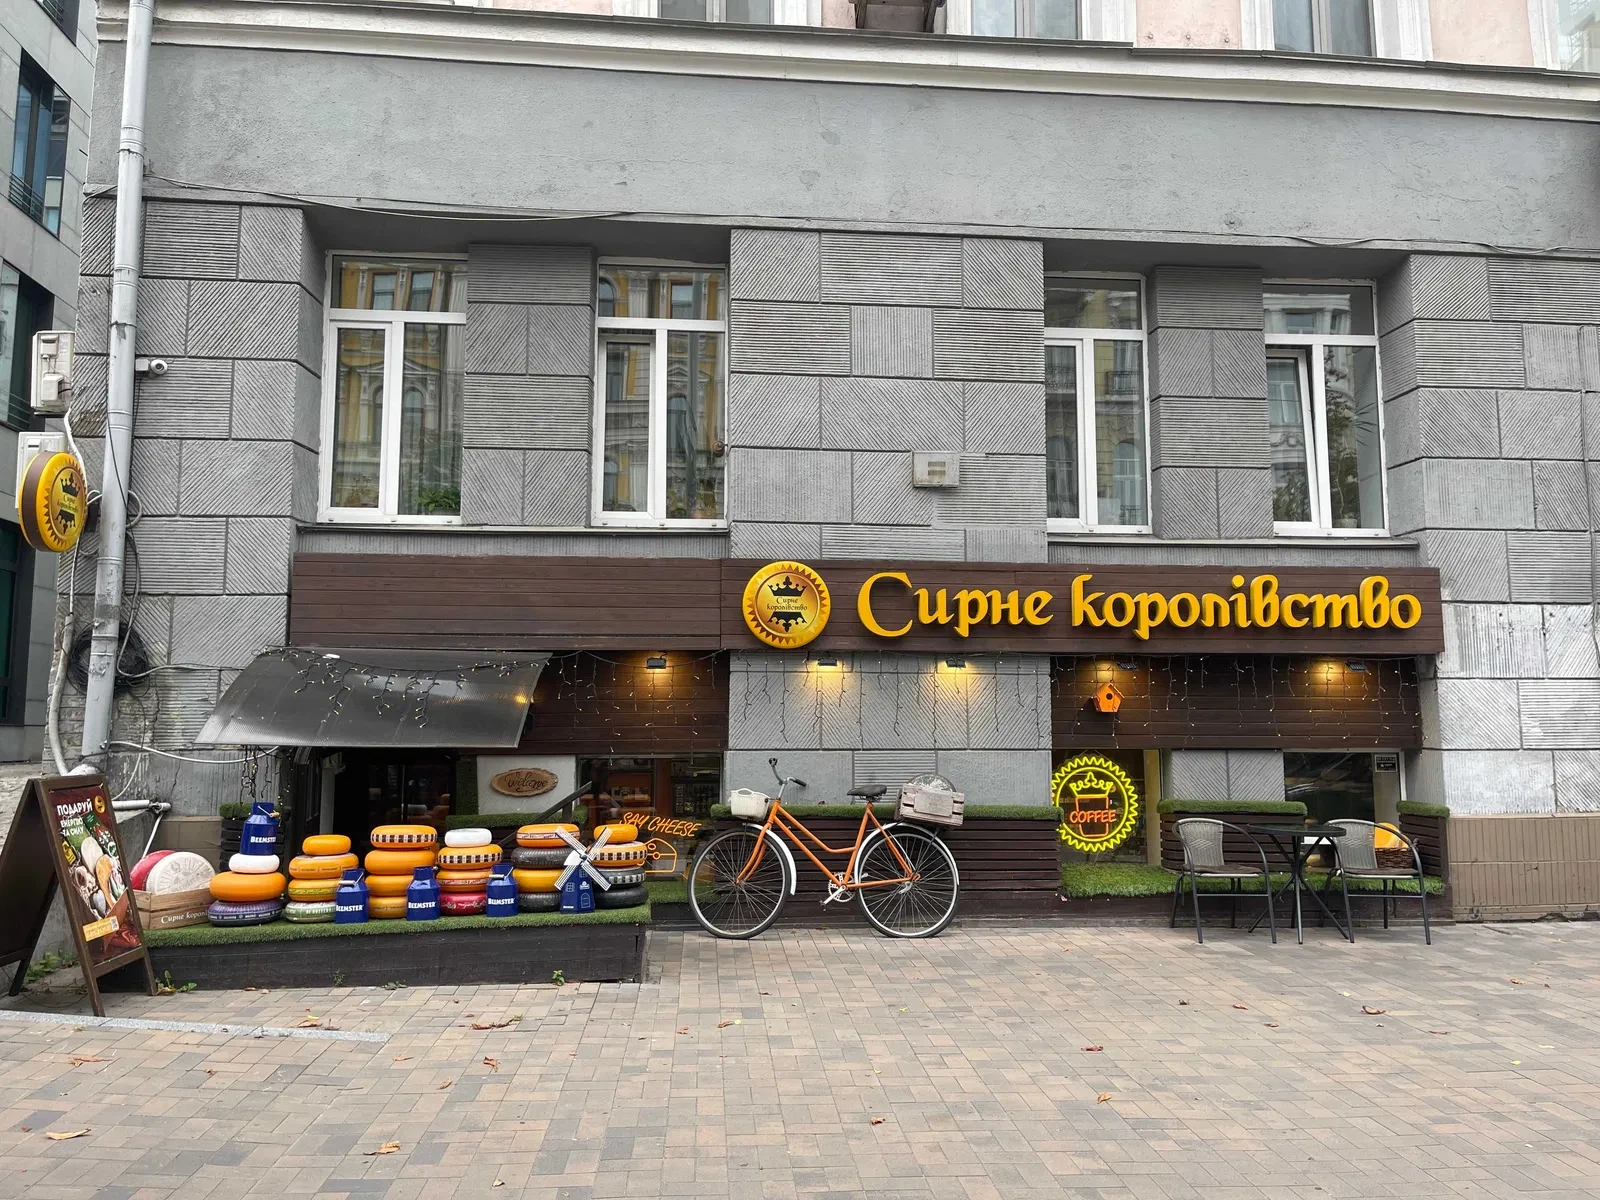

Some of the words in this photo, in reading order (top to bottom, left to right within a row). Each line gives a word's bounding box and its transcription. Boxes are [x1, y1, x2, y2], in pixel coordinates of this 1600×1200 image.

[766, 603, 808, 611] королівство
[776, 596, 798, 604] Сирне
[857, 572, 1054, 638] Сирне
[1071, 574, 1423, 640] королівство
[505, 771, 548, 792] Welcome
[56, 798, 93, 816] ПОДАРУЙ
[1069, 809, 1117, 823] COFFEE
[619, 811, 650, 829] SAY
[647, 816, 702, 837] CHEESE
[335, 904, 363, 912] BEEMSTER
[161, 914, 184, 924] Сирне
